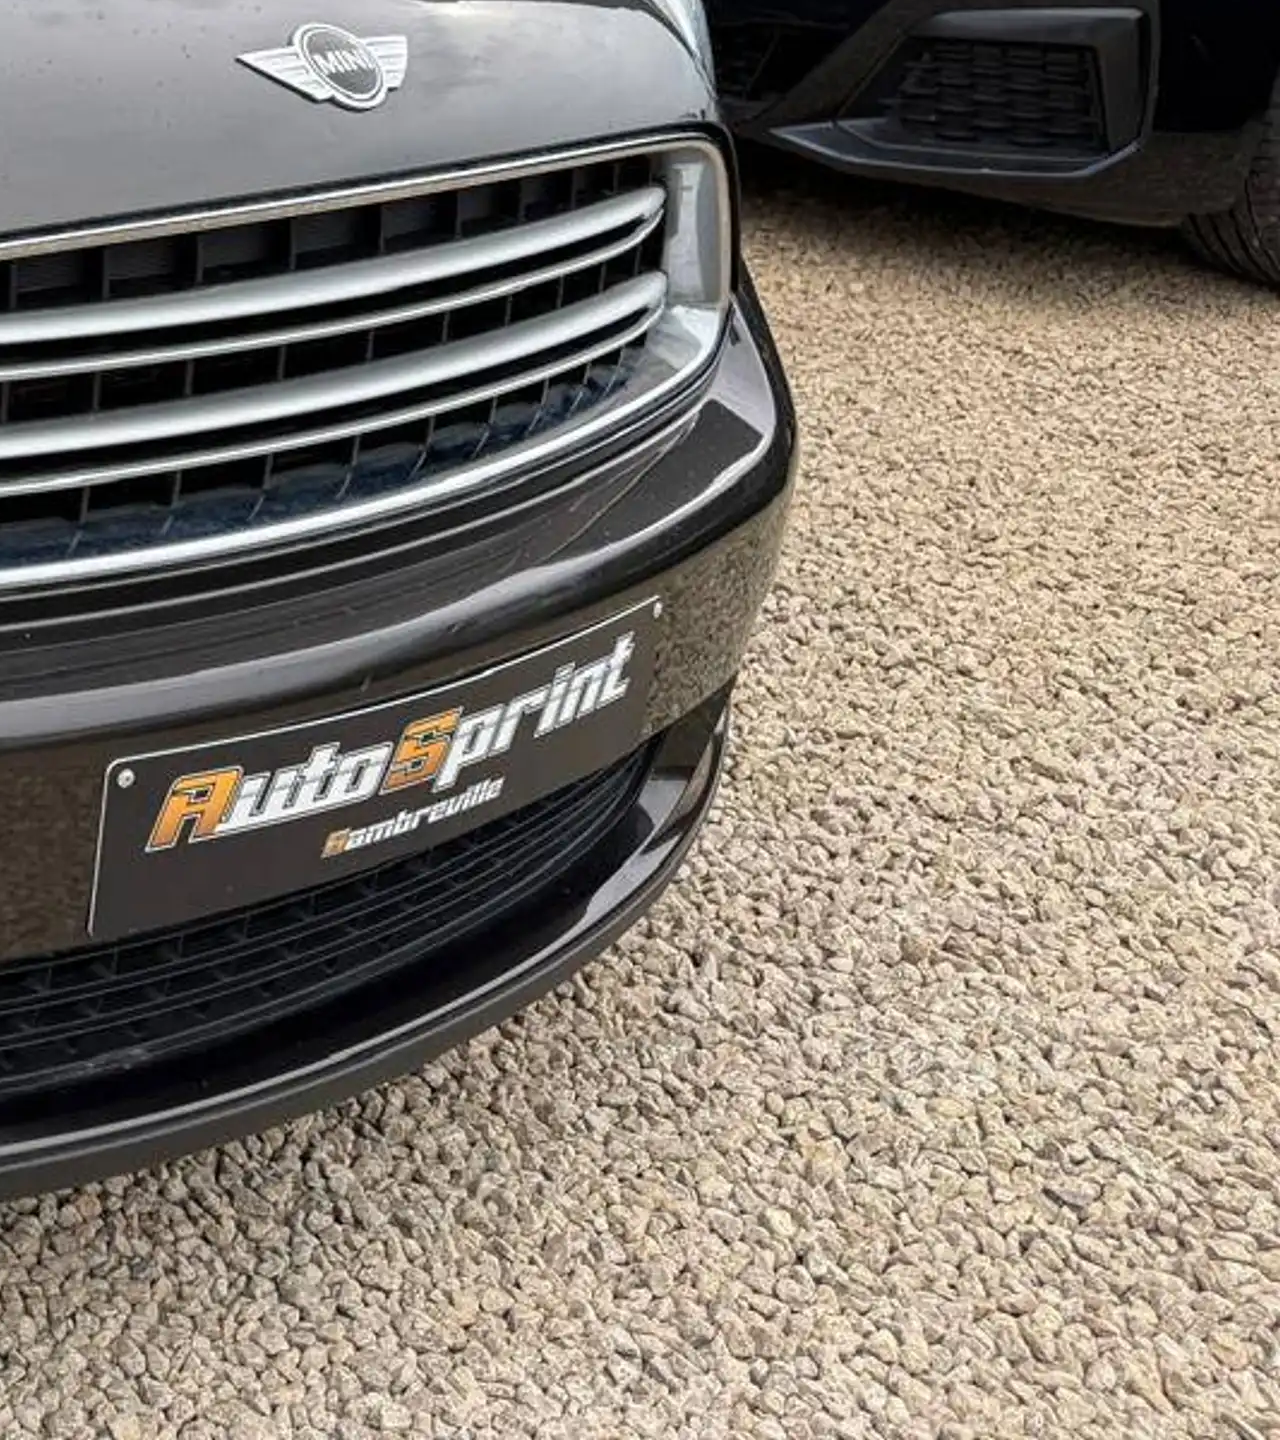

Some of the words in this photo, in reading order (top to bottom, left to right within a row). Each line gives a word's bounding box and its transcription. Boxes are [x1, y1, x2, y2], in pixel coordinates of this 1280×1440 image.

[310, 48, 377, 75] MINI
[145, 632, 634, 852] AutoSprint
[321, 775, 505, 859] Sambreville
